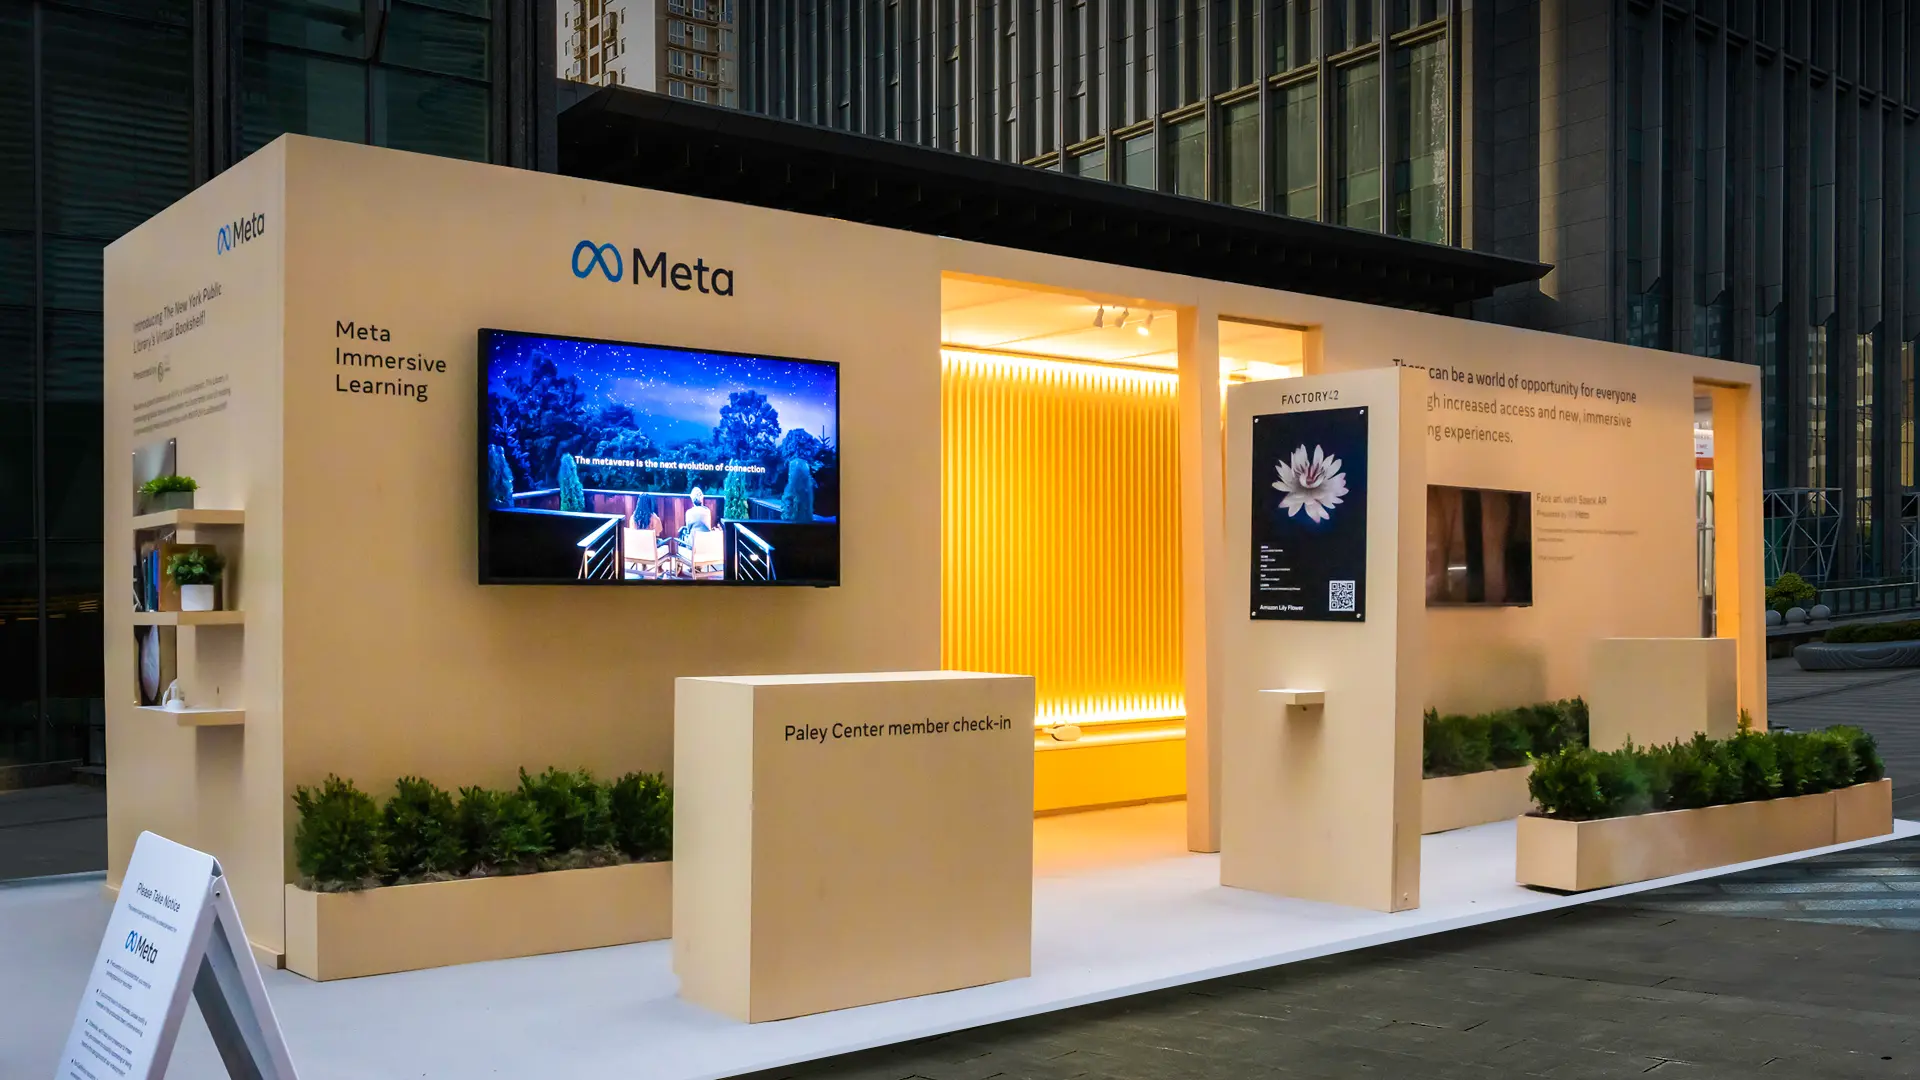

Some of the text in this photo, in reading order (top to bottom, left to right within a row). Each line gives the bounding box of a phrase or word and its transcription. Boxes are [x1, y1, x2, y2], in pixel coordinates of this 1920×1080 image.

[233, 212, 265, 248] Meta
[633, 248, 734, 297] Meta
[164, 305, 174, 318] The
[175, 301, 188, 314] New
[189, 291, 202, 308] York
[203, 282, 222, 302] Public
[336, 321, 391, 342] Meta
[336, 347, 447, 373] Immersive
[336, 374, 429, 402] Learning
[1281, 389, 1339, 405] FACTORY42
[1428, 366, 1637, 404] can be a world of opportunity for everyone
[1443, 394, 1497, 414] increased
[1500, 404, 1535, 418] access
[1538, 405, 1556, 420] and
[1559, 409, 1581, 424] new,
[1583, 409, 1632, 428] immersive
[1444, 425, 1513, 443] experiences.
[575, 455, 591, 465] The
[592, 457, 635, 467] metaverse
[645, 460, 658, 469] the
[660, 461, 677, 470] next
[678, 462, 714, 471] evolution
[715, 463, 725, 471] of
[725, 463, 766, 474] connection
[1279, 604, 1287, 612] Lily
[785, 715, 1012, 744] Paley Center member check-in
[136, 882, 181, 913] Please Take Notice
[134, 935, 159, 965] Meta
